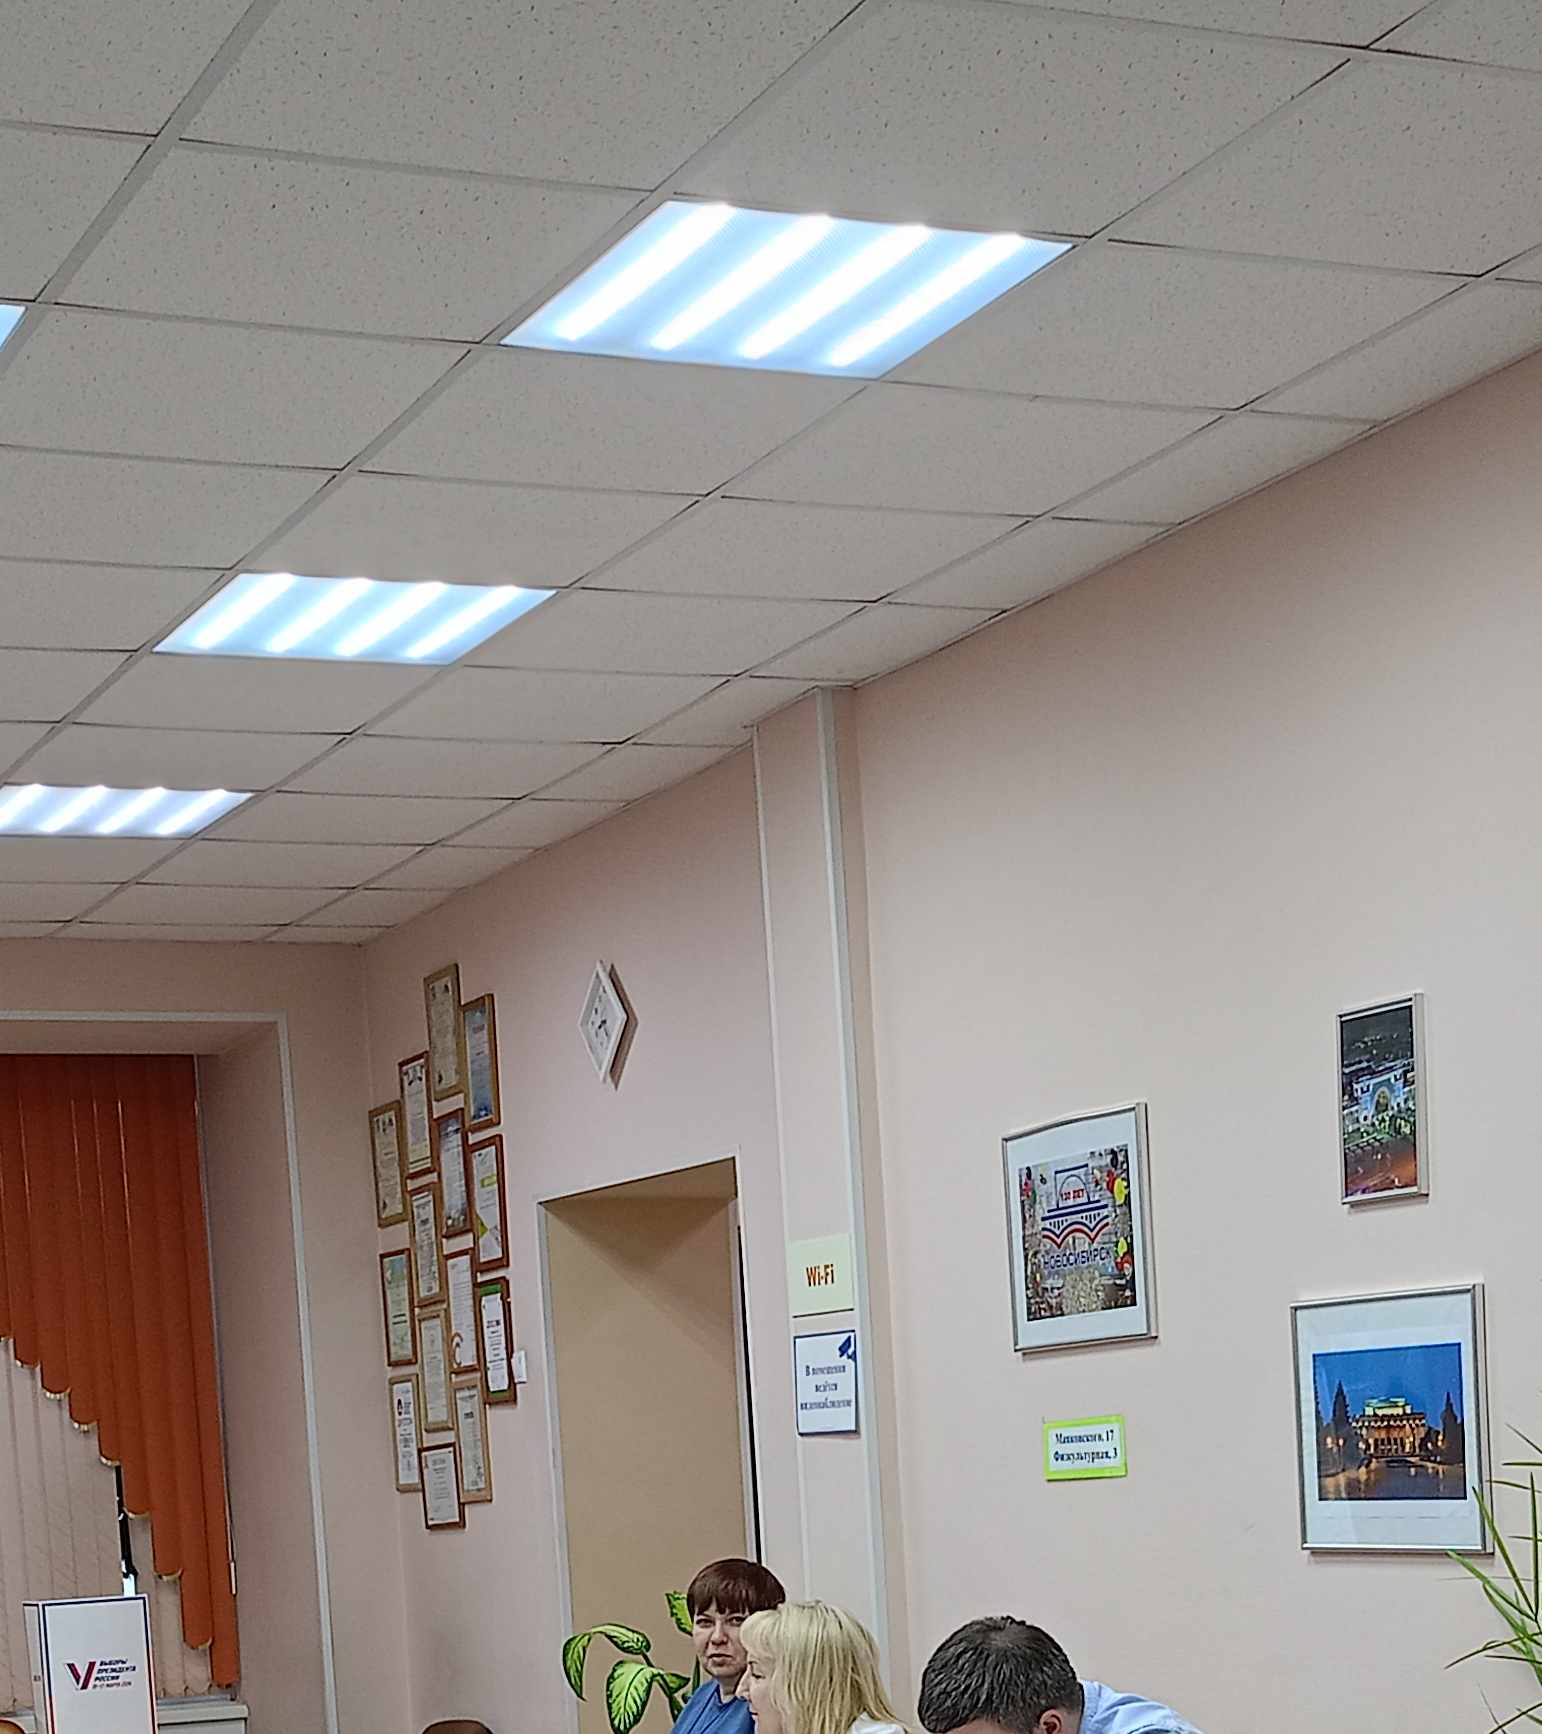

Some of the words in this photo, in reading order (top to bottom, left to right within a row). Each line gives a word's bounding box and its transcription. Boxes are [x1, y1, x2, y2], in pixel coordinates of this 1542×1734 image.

[1042, 1246, 1112, 1270] НОВОСИБИРСК
[806, 1263, 834, 1287] Wi-Fi
[1106, 1429, 1114, 1442] 17
